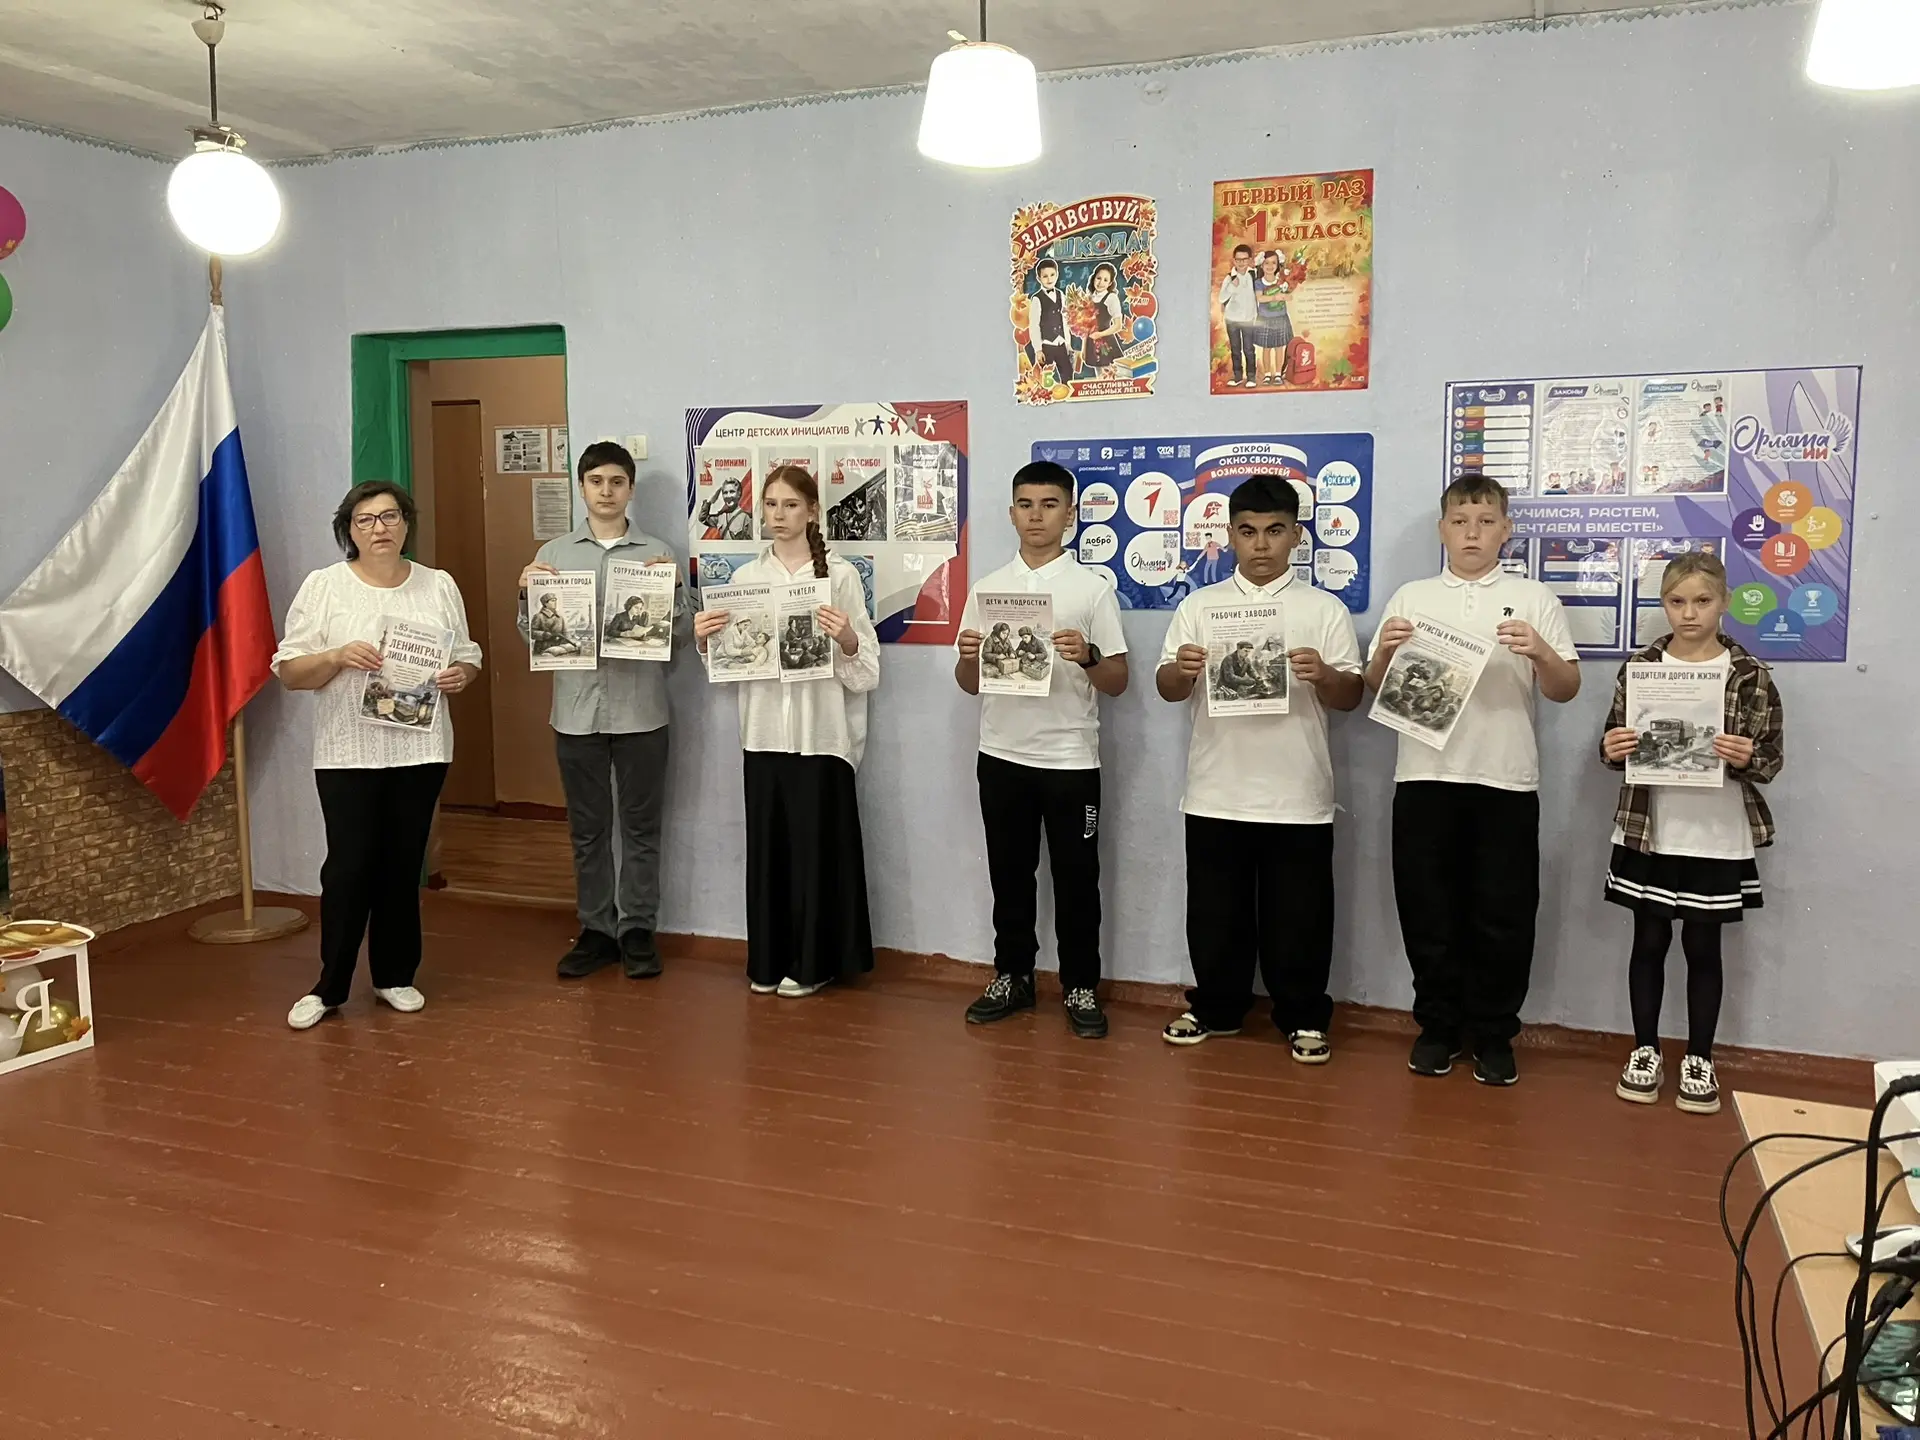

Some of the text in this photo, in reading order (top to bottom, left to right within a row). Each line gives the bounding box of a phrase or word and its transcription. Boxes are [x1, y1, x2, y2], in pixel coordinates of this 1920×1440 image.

[1221, 178, 1366, 207] ПЕРВЫЙ РАЗ
[1302, 204, 1317, 222] В
[1021, 198, 1141, 251] ЗДРАВСТВУЙ,
[1245, 209, 1366, 243] 1 КЛАСС!
[1053, 230, 1150, 257] ШКОЛА!
[1077, 386, 1142, 396] ШКОЛЬНЫХ ЛЕТ!
[1082, 380, 1134, 390] СЧАСТЛИВЫХ
[715, 425, 850, 438] ЦЕНТР ДЕТСКИХ ИНИЦИАТИВ
[1734, 415, 1830, 456] Орлята
[1232, 443, 1271, 454] ОТКРОЙ
[1756, 447, 1829, 460] РОССИИ
[714, 459, 747, 467] ПОМНИМ!
[1219, 455, 1283, 466] ОКНО СВОИХ
[1210, 466, 1291, 479] ВОЗМОЖНОСТЕЙ
[1327, 475, 1352, 485] ОКЕАН
[1588, 506, 1660, 519] РАСТЕМ,
[1194, 522, 1232, 530] ЮНАРМИЯ
[1585, 521, 1664, 533] ВМЕСТЕ!»
[1323, 528, 1351, 537] АРТЕК
[613, 567, 672, 578] СОТРУДНИКИ РАДИО
[1328, 567, 1356, 577] Сириус
[532, 577, 592, 586] ЗАЩИТНИКИ ГОРОДА
[706, 587, 770, 600] МЕДИЦИНСКИЕ РАБОТНИКИ
[788, 586, 816, 597] УЧИТЕЛЯ
[985, 598, 1002, 606] ДЕТИ
[1010, 598, 1048, 606] ПОДРОСТКИ
[1211, 608, 1277, 620] РАБОЧИЕ ЗАВОДОВ
[1416, 620, 1444, 638] АРТИСТЫ
[1449, 634, 1486, 656] МУЗЫКАНТЫ
[389, 638, 444, 660] ЛЕНИНГРАД.
[385, 650, 442, 670] ЛИЦА ПОДВИГА
[1631, 671, 1721, 681] ВОДИТЕЛИ ДОРОГИ ЖИЗНИ
